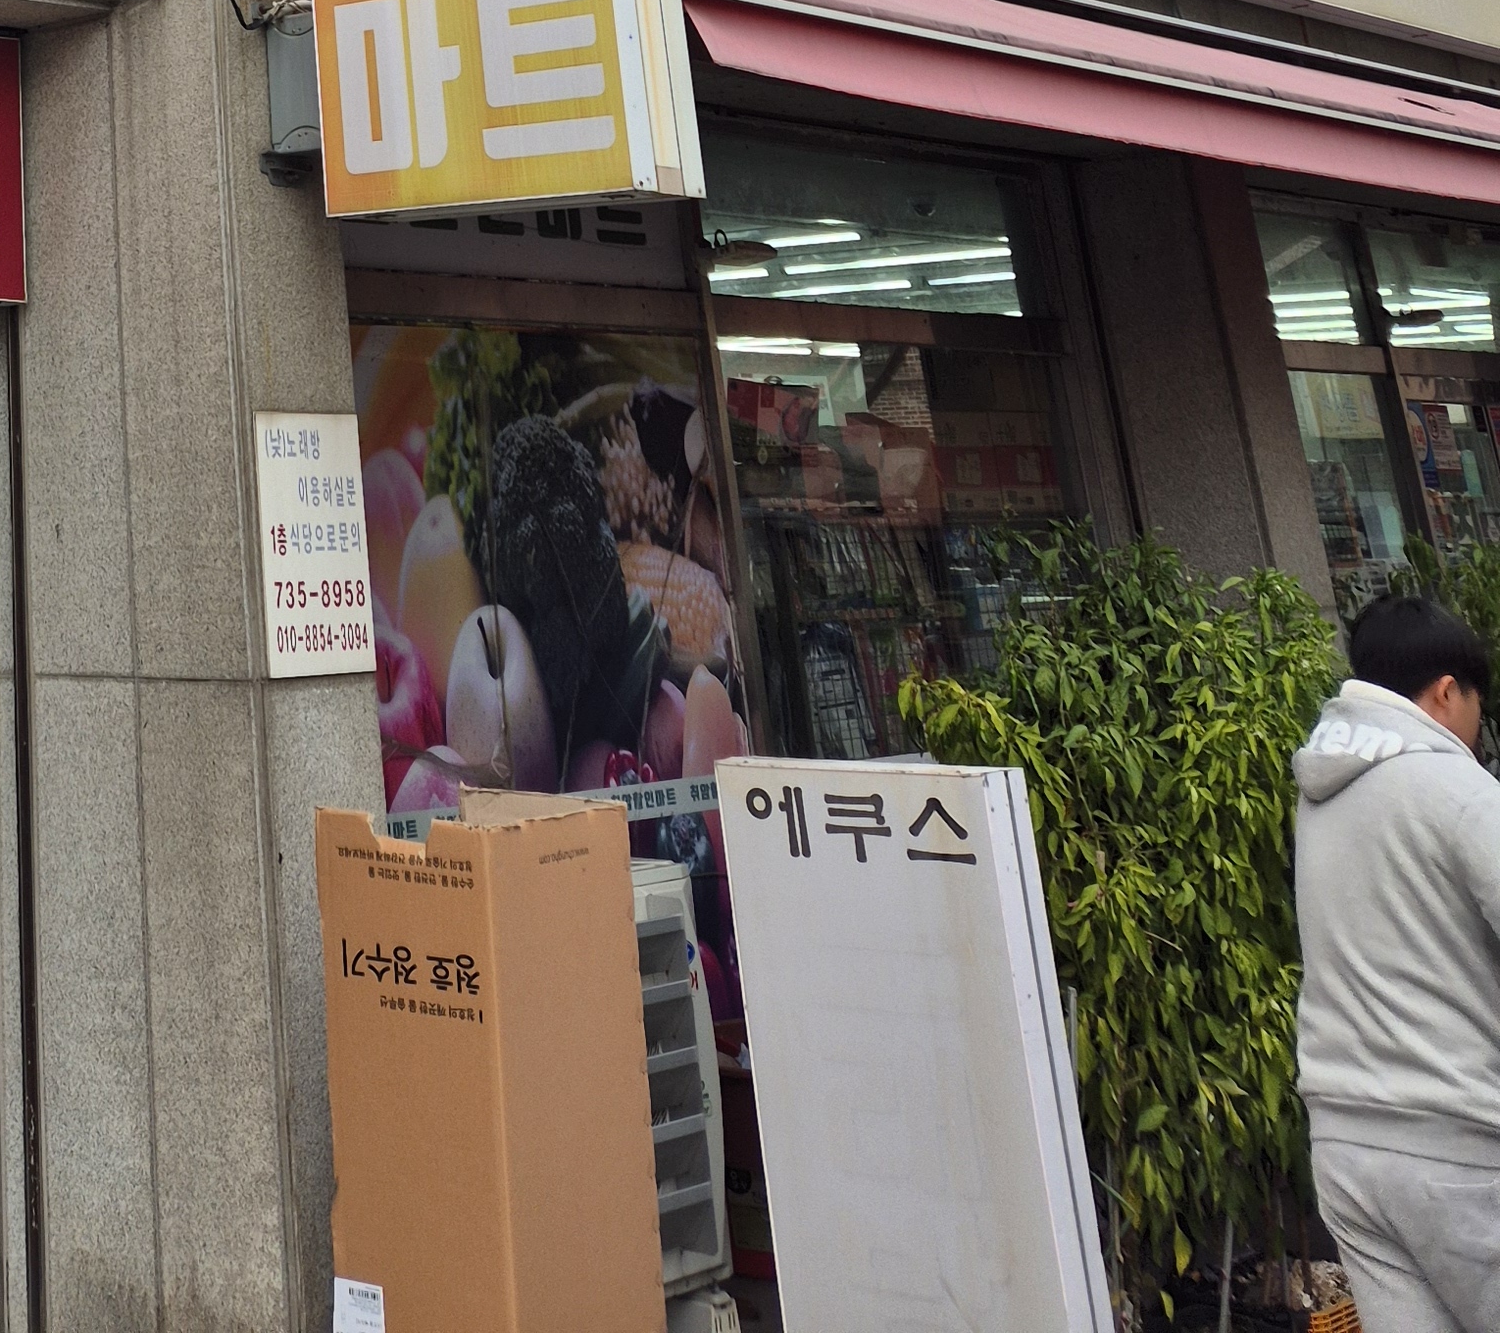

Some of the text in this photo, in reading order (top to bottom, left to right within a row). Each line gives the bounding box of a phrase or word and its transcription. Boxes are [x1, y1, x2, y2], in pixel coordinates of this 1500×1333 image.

[274, 580, 366, 609] 735-8958
[277, 623, 368, 653] 010-8854-3094
[386, 819, 418, 839] 마트
[746, 786, 977, 865] 에쿠스
[341, 938, 480, 996] 청호 정수기
